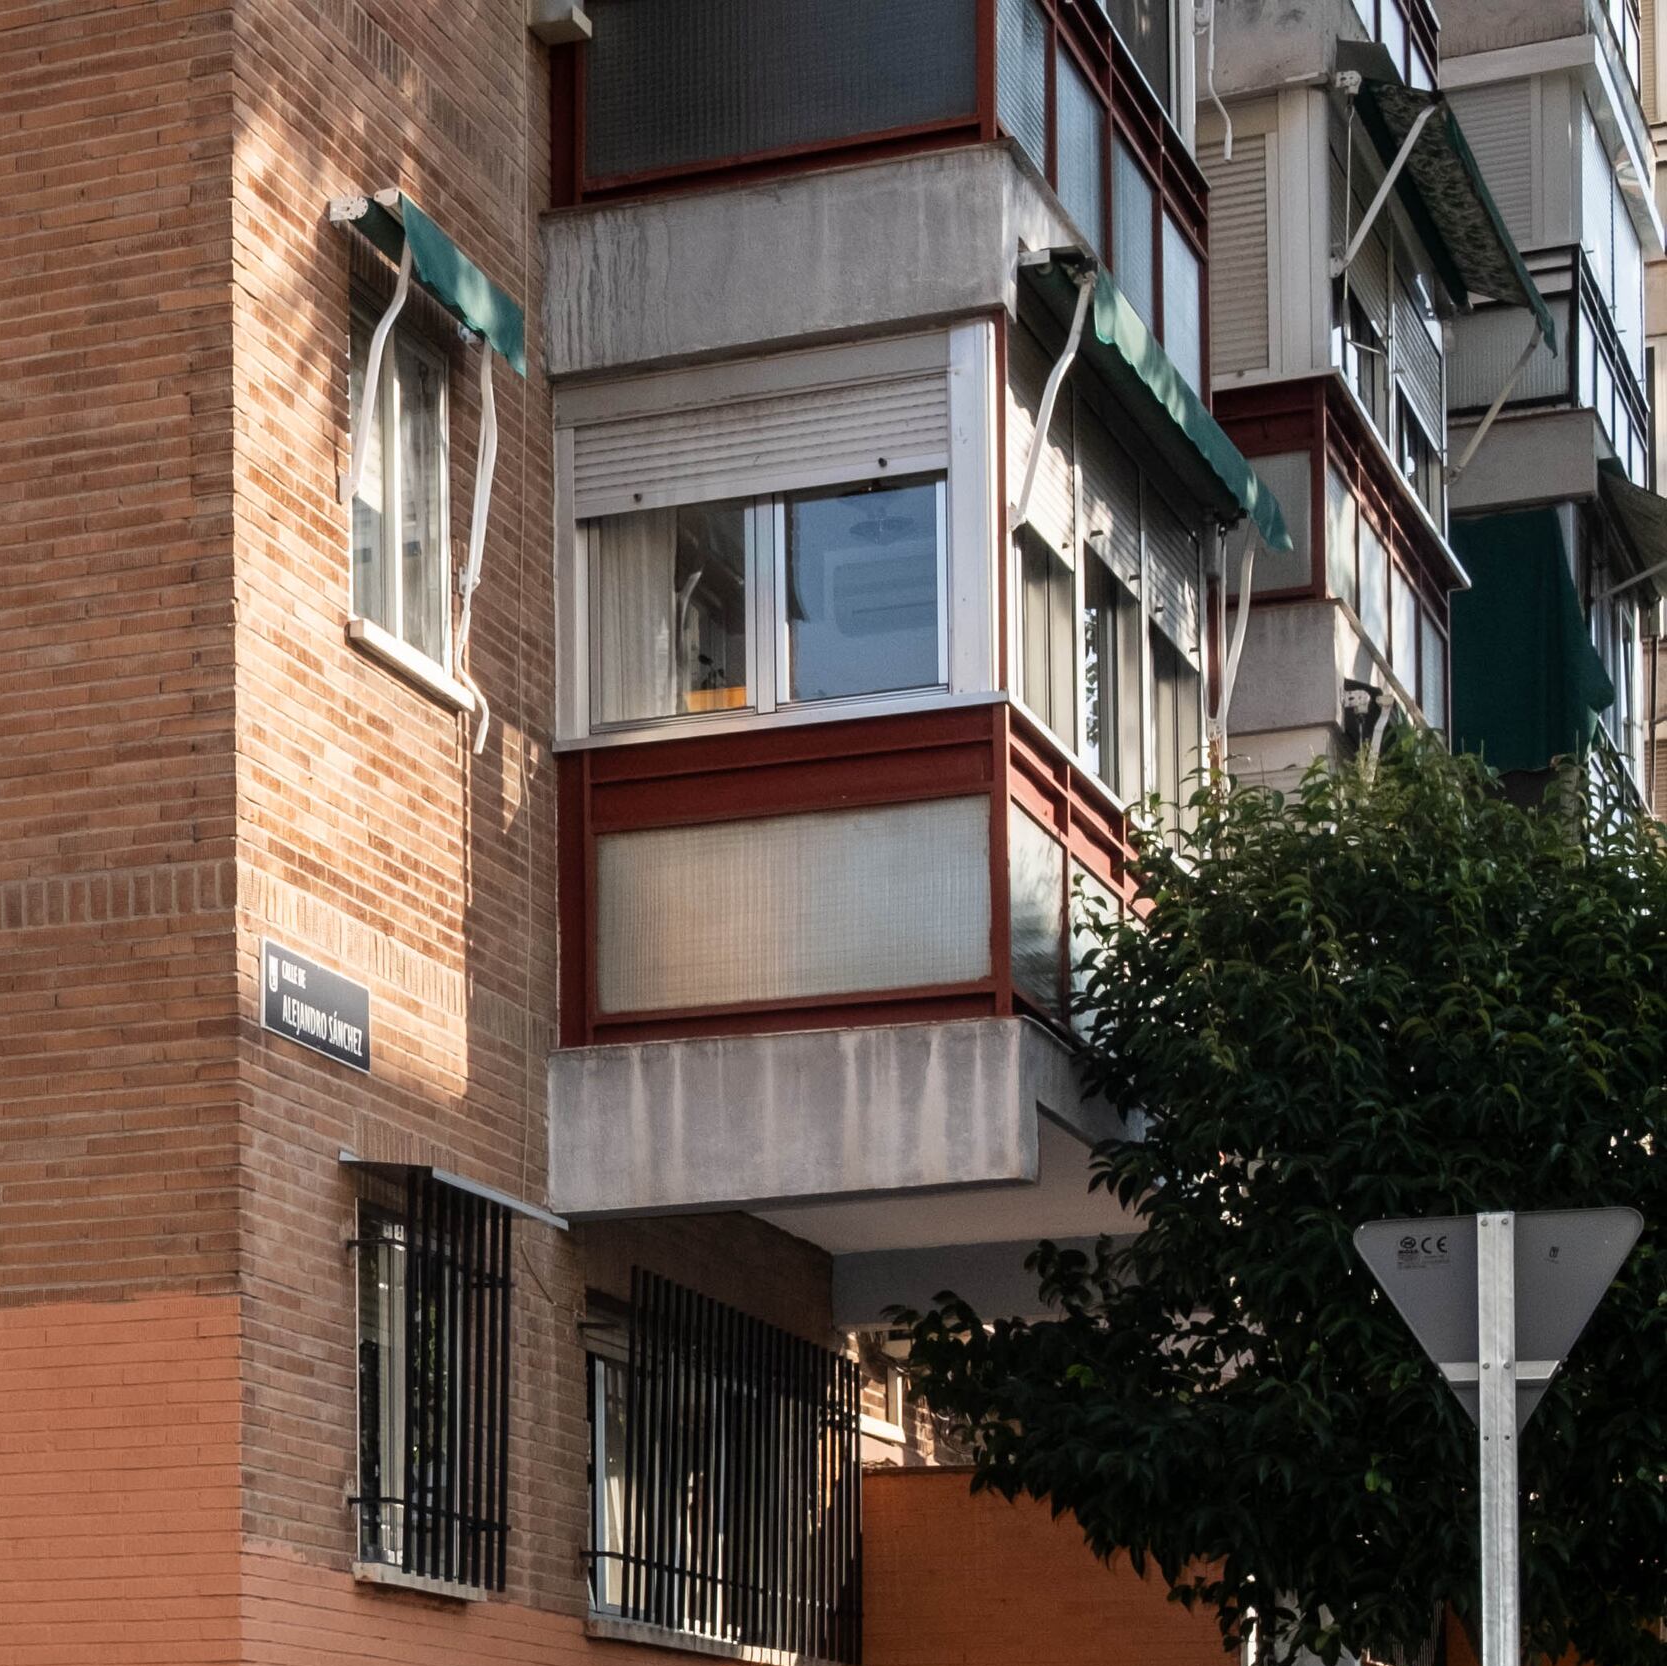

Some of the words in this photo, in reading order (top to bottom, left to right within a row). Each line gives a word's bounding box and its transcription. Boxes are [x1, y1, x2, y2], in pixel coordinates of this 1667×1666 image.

[281, 959, 297, 985] CALLE
[282, 994, 327, 1041] ALEJANDRO
[328, 1010, 364, 1057] SÁNCHEZ
